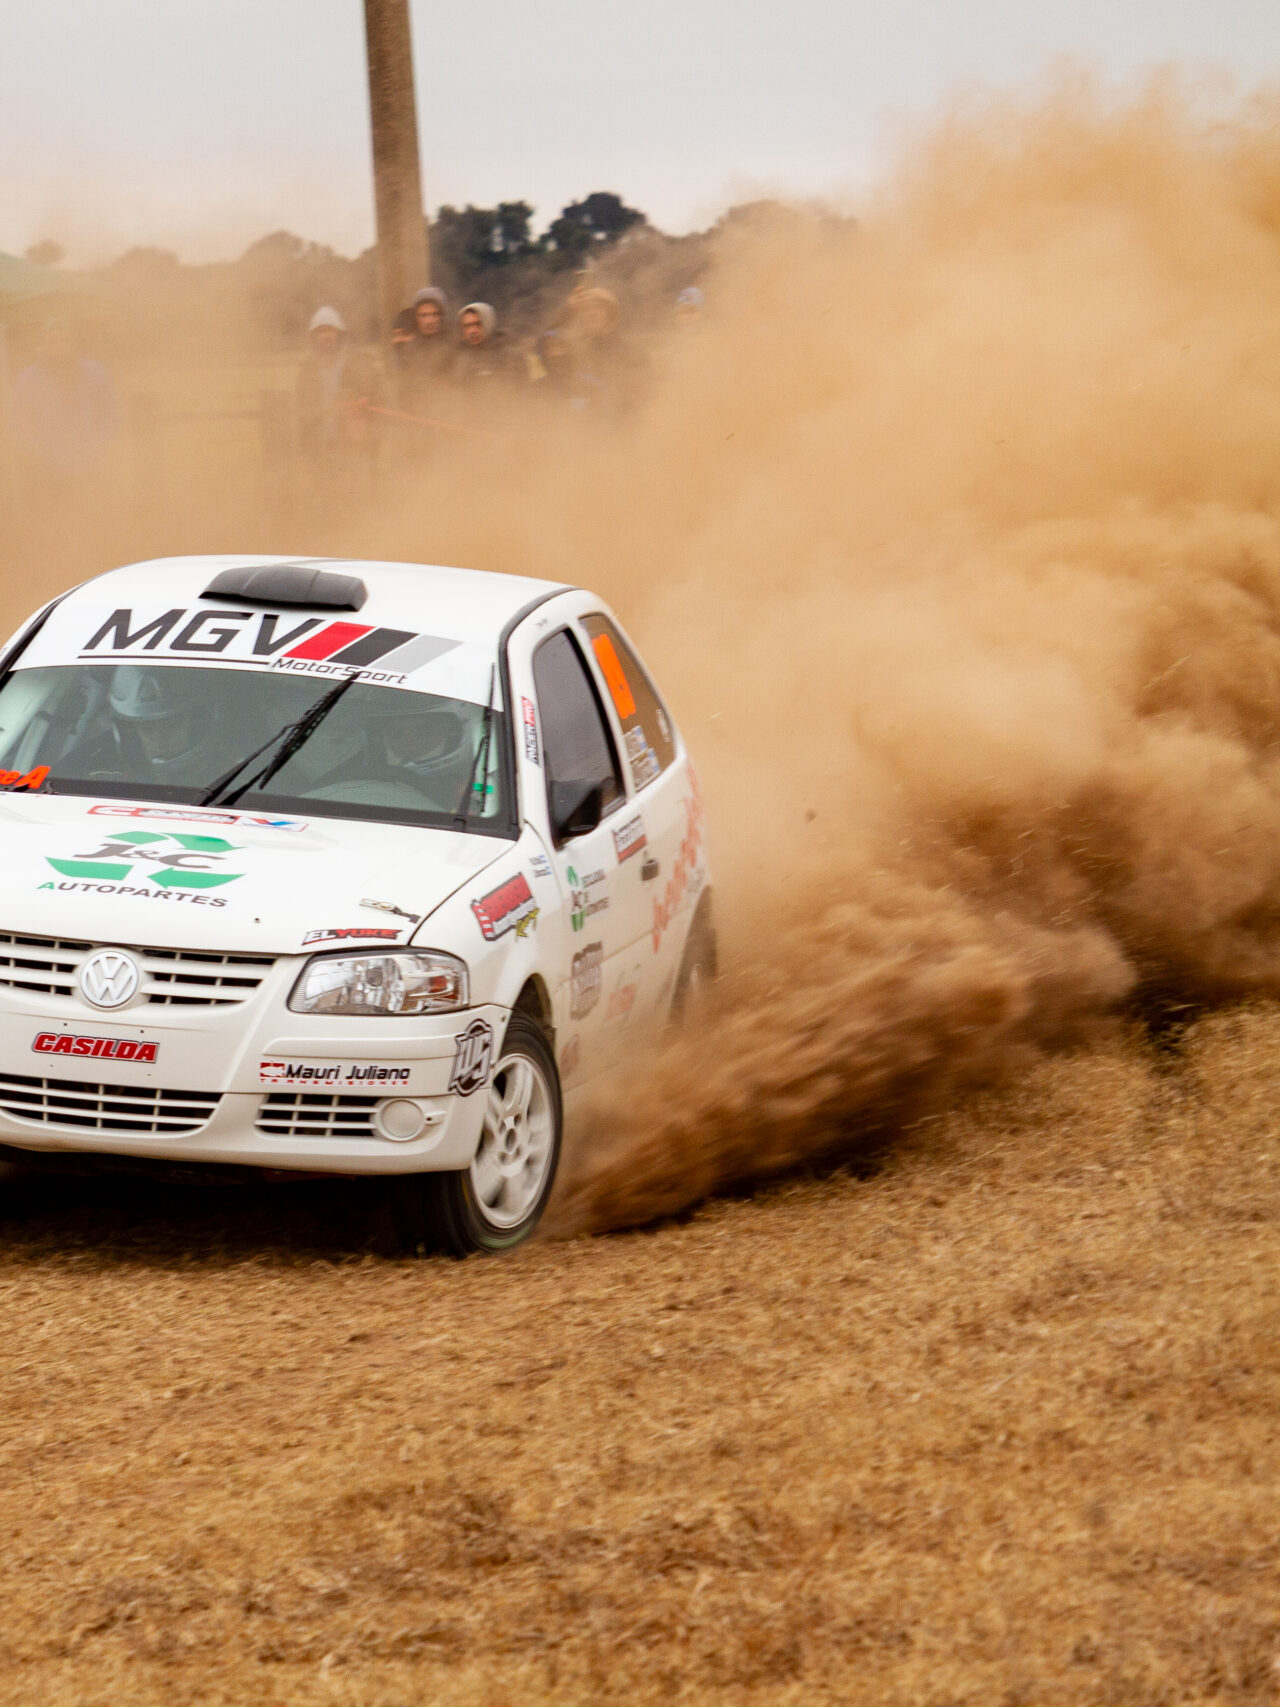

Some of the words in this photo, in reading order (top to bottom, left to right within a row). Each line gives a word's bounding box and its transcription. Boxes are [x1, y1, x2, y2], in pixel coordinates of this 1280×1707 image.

[82, 608, 326, 656] MGV
[272, 658, 408, 684] MotorSport
[14, 765, 51, 789] A
[73, 843, 228, 869] J&C
[36, 881, 229, 907] AUTOPARTES
[33, 1033, 158, 1062] CASILDA
[286, 1064, 341, 1079] Mauri
[346, 1065, 411, 1080] Juliano
